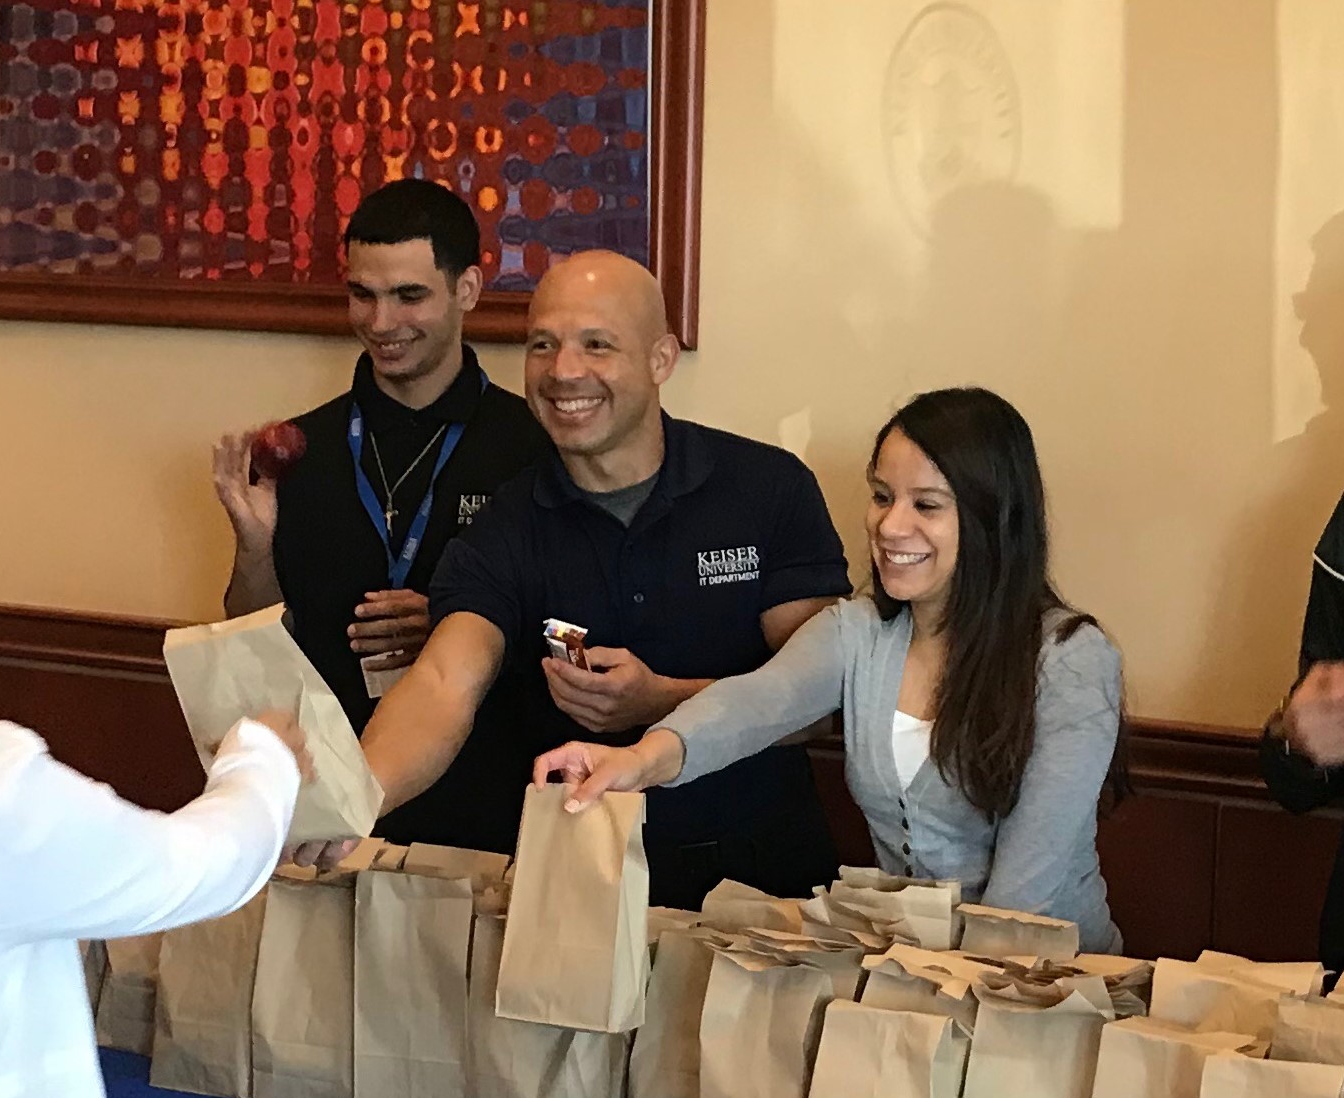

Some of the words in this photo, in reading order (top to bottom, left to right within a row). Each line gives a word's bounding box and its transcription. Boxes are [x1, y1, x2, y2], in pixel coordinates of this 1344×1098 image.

[697, 546, 759, 566] KEISER
[698, 560, 759, 577] UNIVERSITY
[699, 577, 707, 586] IT
[708, 570, 760, 585] DEPARTMENT
